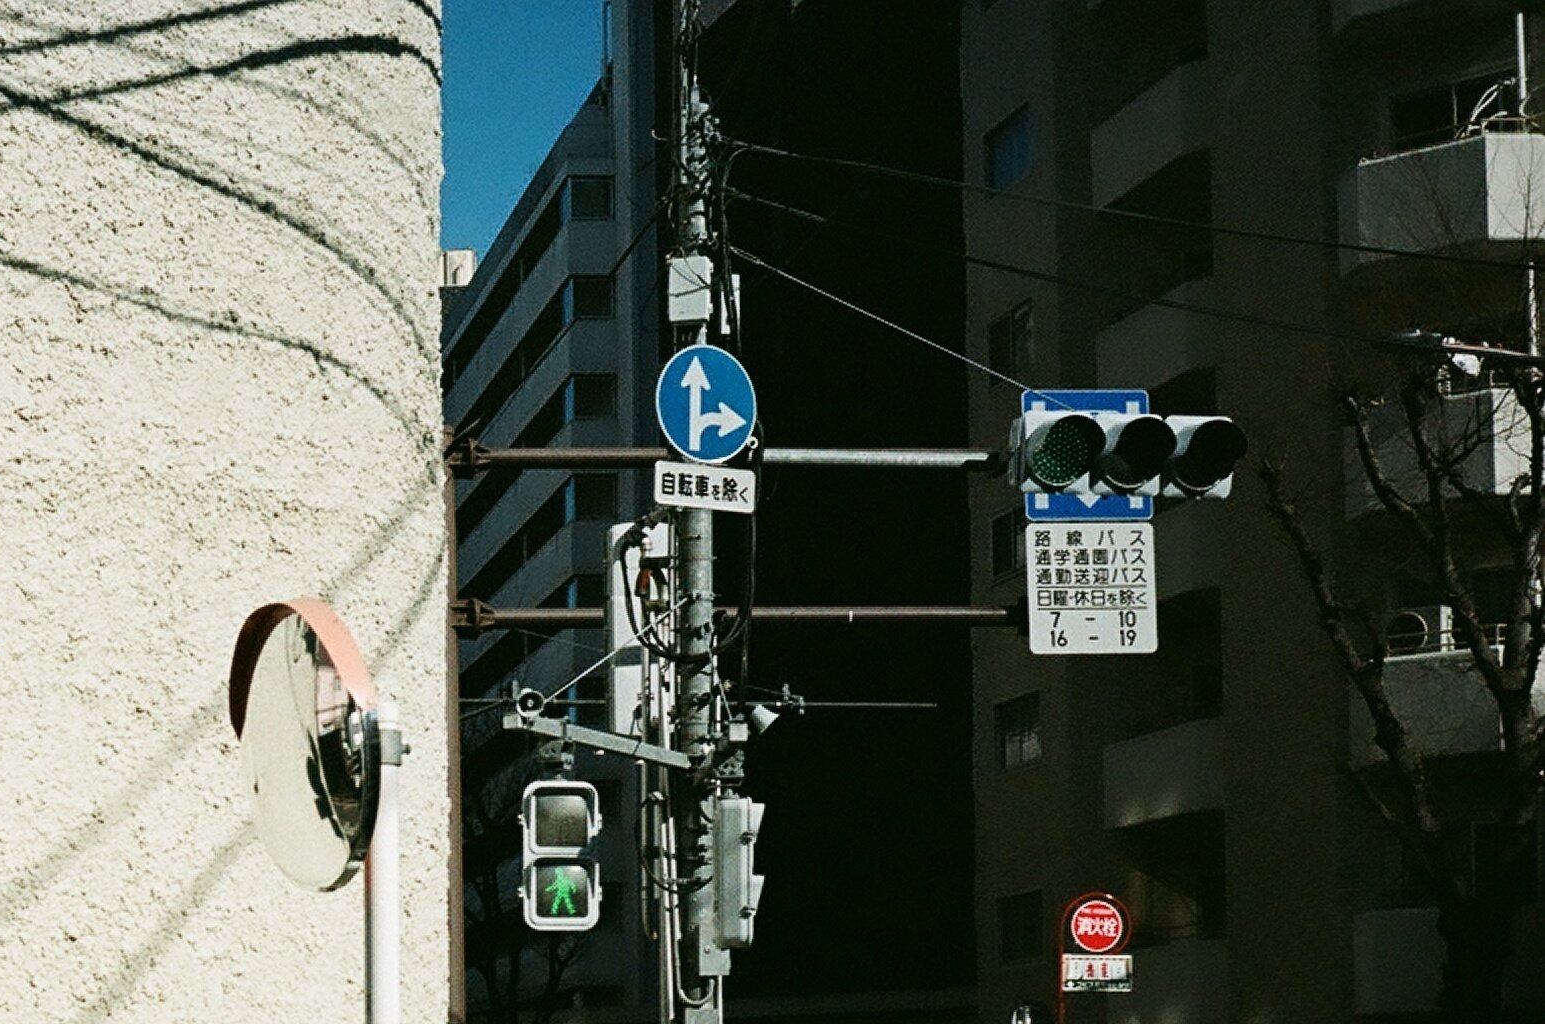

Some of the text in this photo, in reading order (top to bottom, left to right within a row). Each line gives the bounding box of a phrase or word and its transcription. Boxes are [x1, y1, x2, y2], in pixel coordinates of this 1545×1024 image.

[661, 471, 749, 505] 自転車を除く
[1034, 548, 1148, 566] 通学通園バス
[1035, 567, 1148, 585] 通勤送迎バス
[1049, 611, 1061, 628] 7
[1118, 610, 1137, 628] 10
[1050, 630, 1069, 647] 16
[1119, 629, 1137, 647] 19
